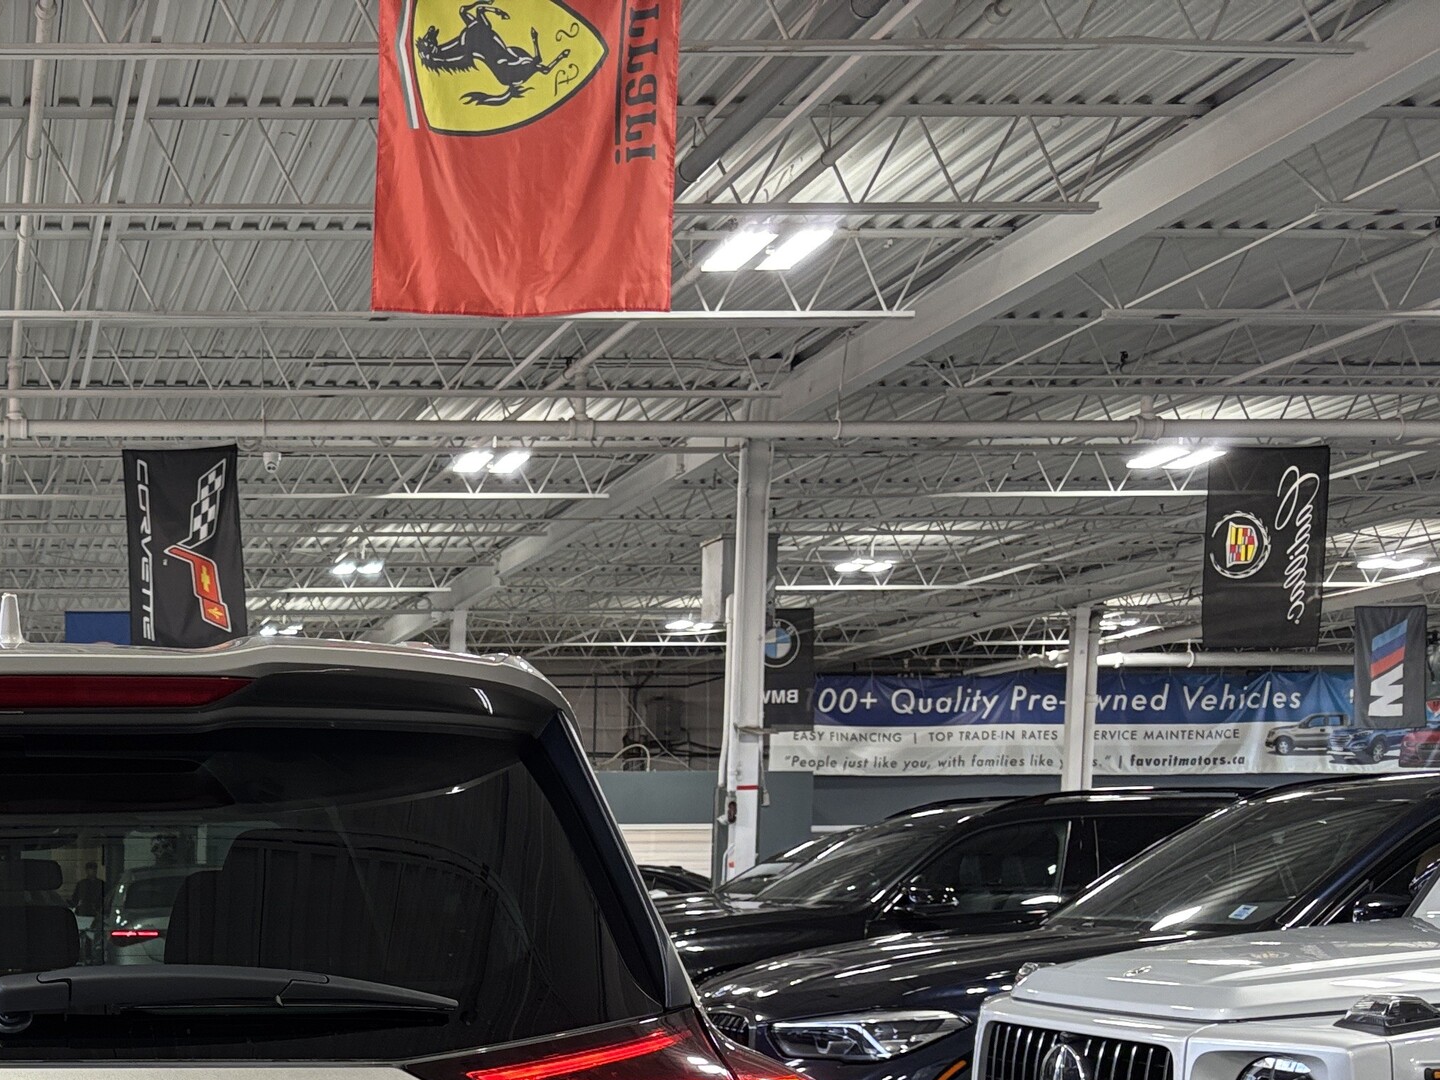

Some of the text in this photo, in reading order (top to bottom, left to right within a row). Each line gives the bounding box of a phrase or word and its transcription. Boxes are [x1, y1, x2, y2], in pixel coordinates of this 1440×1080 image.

[136, 459, 156, 642] CORVETTE
[891, 685, 999, 720] Quality
[1183, 681, 1302, 711] Vehicles
[793, 728, 1240, 743] EASY FINANCING TOP TRADE-IN RATES ERVICE MAINTENANCE
[842, 756, 869, 770] just
[873, 755, 897, 768] like
[903, 759, 931, 771] you,
[937, 755, 965, 768] with
[971, 754, 1025, 767] families
[1030, 754, 1054, 767] like
[1129, 754, 1246, 768] favoritmotors.ca
